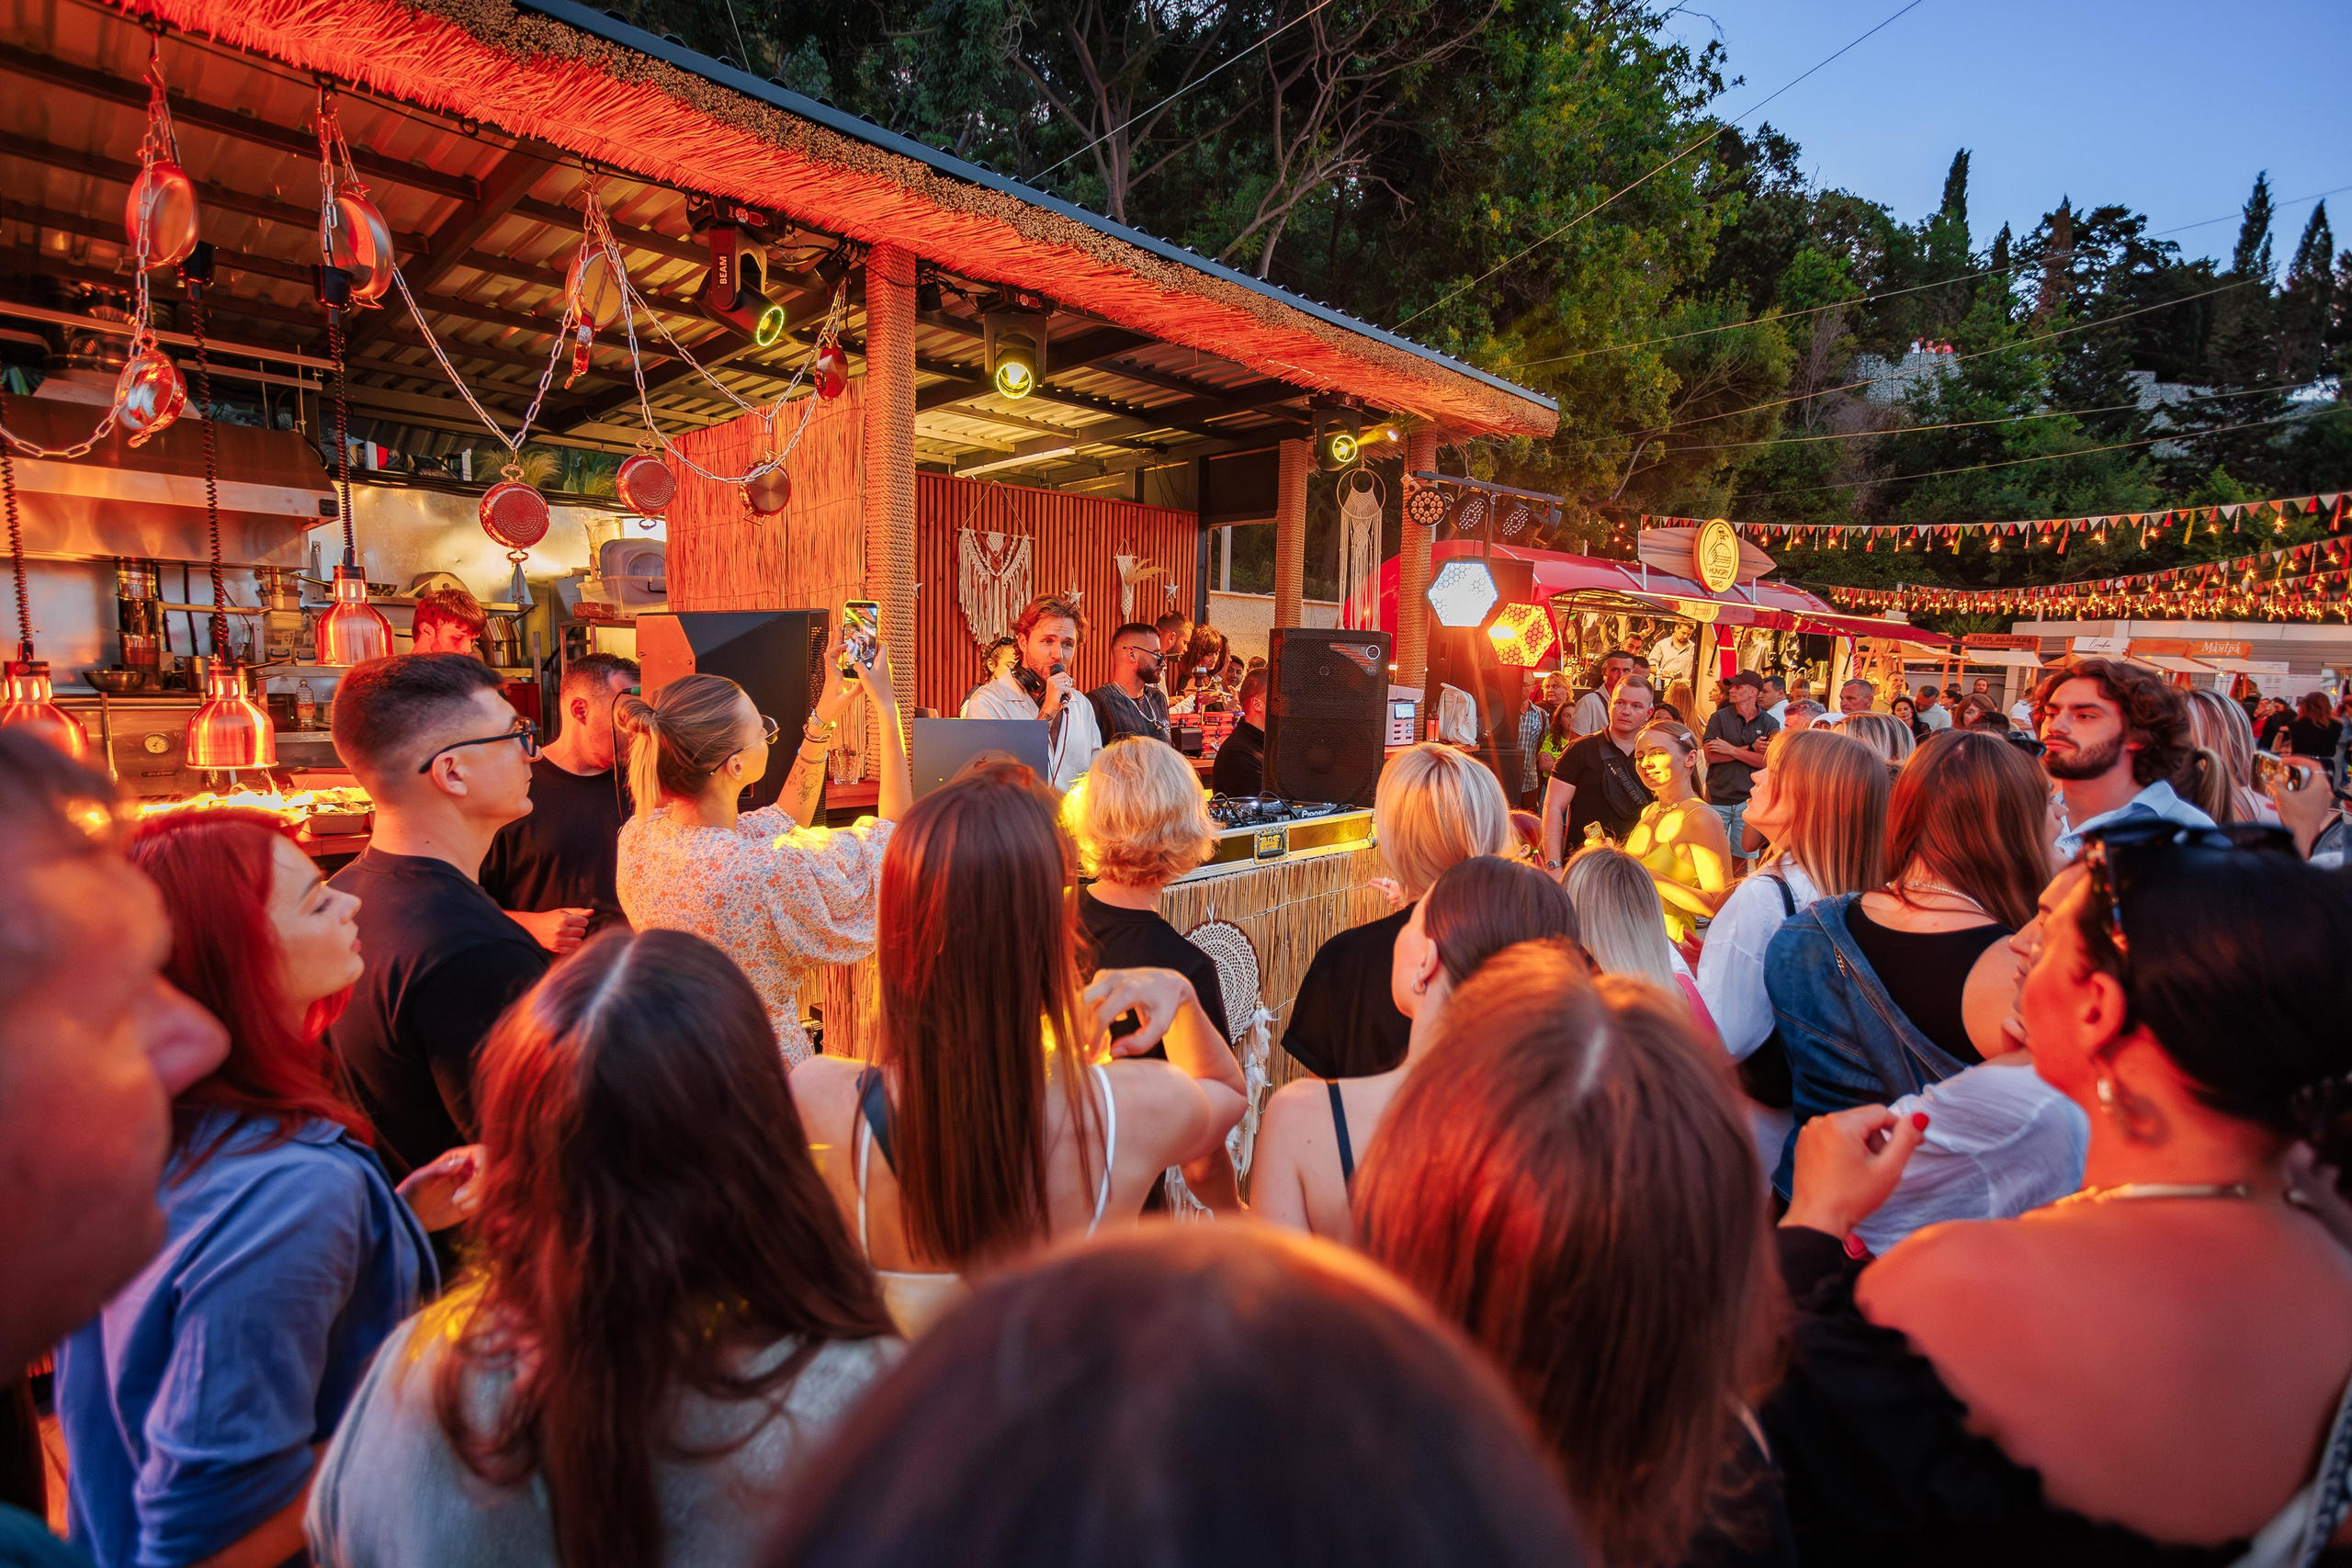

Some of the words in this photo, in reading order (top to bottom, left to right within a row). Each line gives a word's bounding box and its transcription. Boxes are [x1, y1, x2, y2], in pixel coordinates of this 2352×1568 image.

[1709, 567, 1729, 576] HUNGRY
[1711, 579, 1724, 588] BIRD
[1301, 809, 1330, 818] Pioneer
